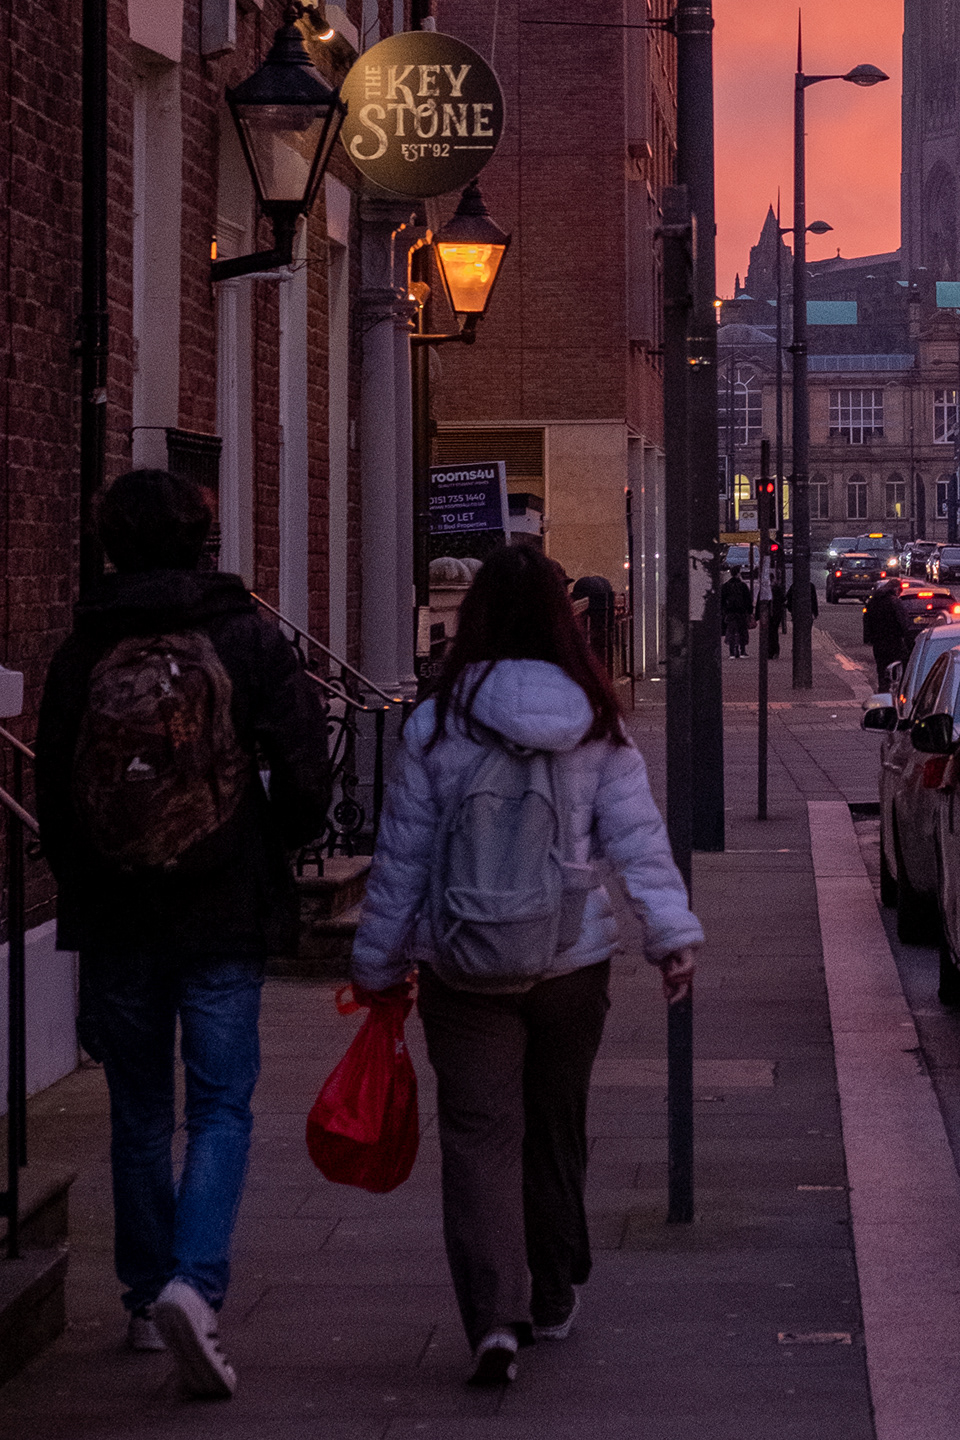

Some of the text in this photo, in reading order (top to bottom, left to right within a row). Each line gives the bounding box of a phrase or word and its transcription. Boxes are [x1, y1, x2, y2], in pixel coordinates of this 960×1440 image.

[365, 64, 381, 100] THE
[385, 64, 472, 103] KEY
[350, 102, 494, 160] STONE
[431, 469, 495, 484] rooms4u
[448, 494, 464, 503] 735
[441, 512, 475, 523] TO LET
